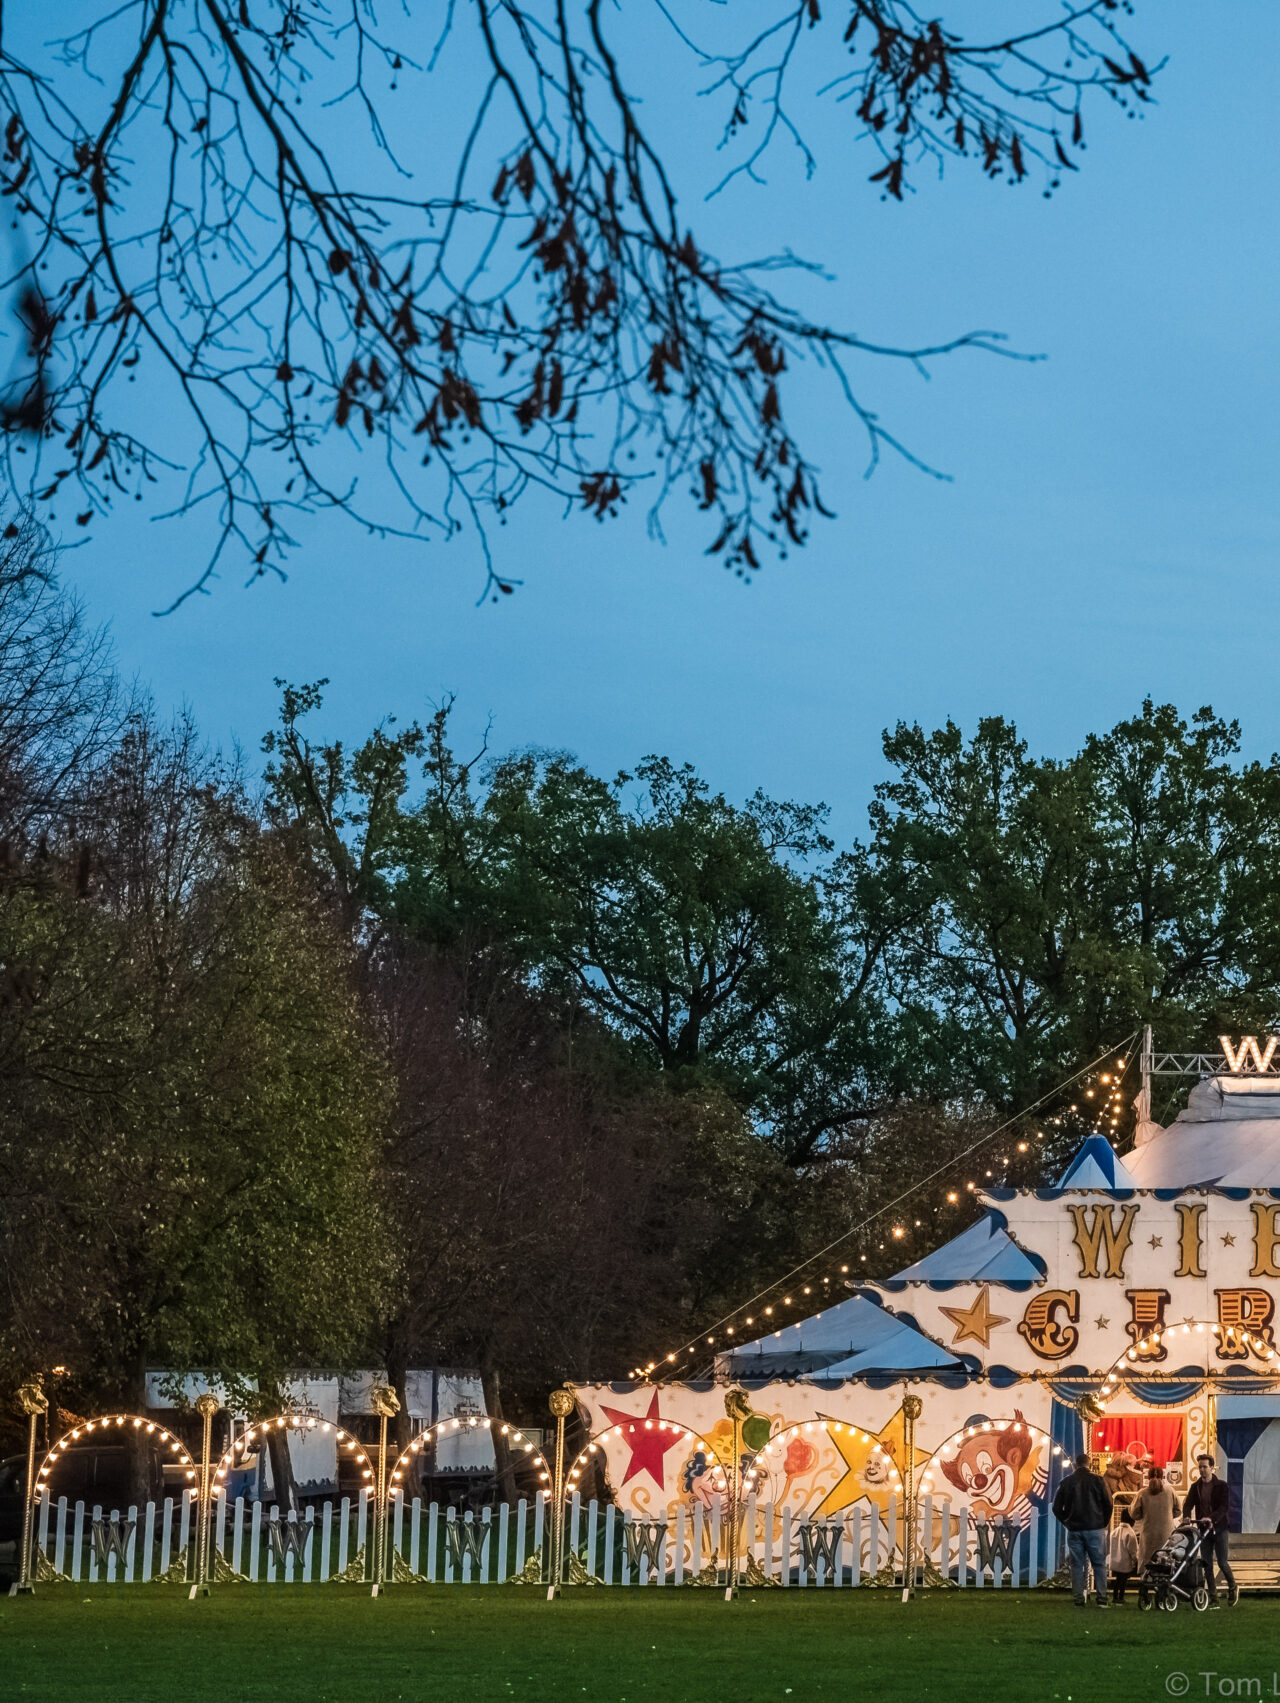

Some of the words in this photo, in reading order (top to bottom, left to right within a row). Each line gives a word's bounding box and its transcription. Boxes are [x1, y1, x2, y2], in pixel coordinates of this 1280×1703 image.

[91, 1520, 137, 1568] W
[267, 1520, 314, 1568] W
[445, 1521, 491, 1569] W
[622, 1523, 668, 1573] W
[799, 1524, 845, 1574] W
[974, 1525, 1022, 1575] W
